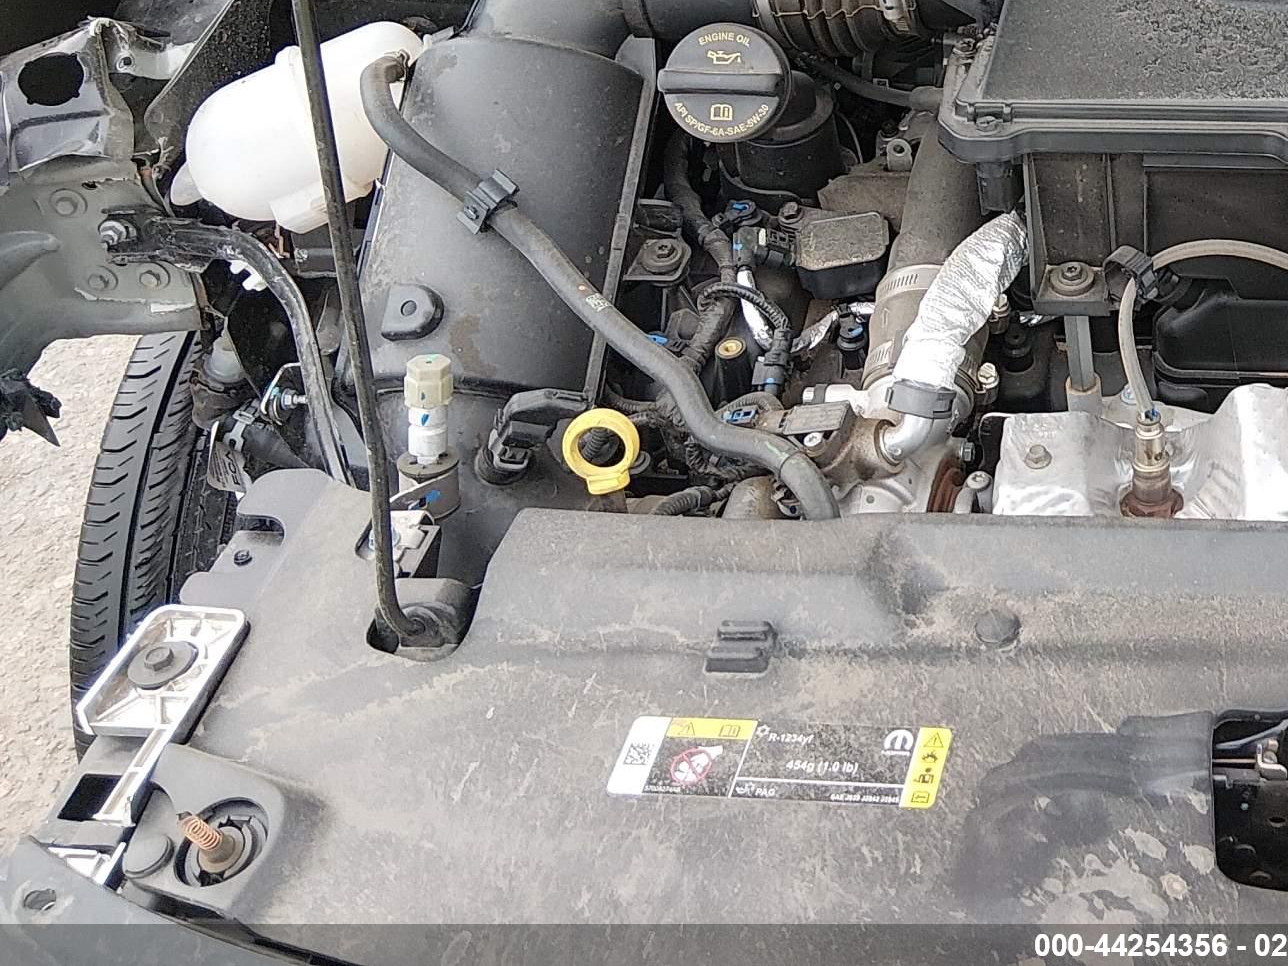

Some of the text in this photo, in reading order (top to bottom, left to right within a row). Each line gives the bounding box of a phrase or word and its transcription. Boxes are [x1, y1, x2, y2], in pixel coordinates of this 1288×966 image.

[697, 32, 751, 47] ENGINE OIL
[674, 101, 687, 118] API
[225, 451, 241, 486] FCA
[768, 732, 814, 747] R-1234yf
[785, 759, 859, 775] 454g (1.0 lb)
